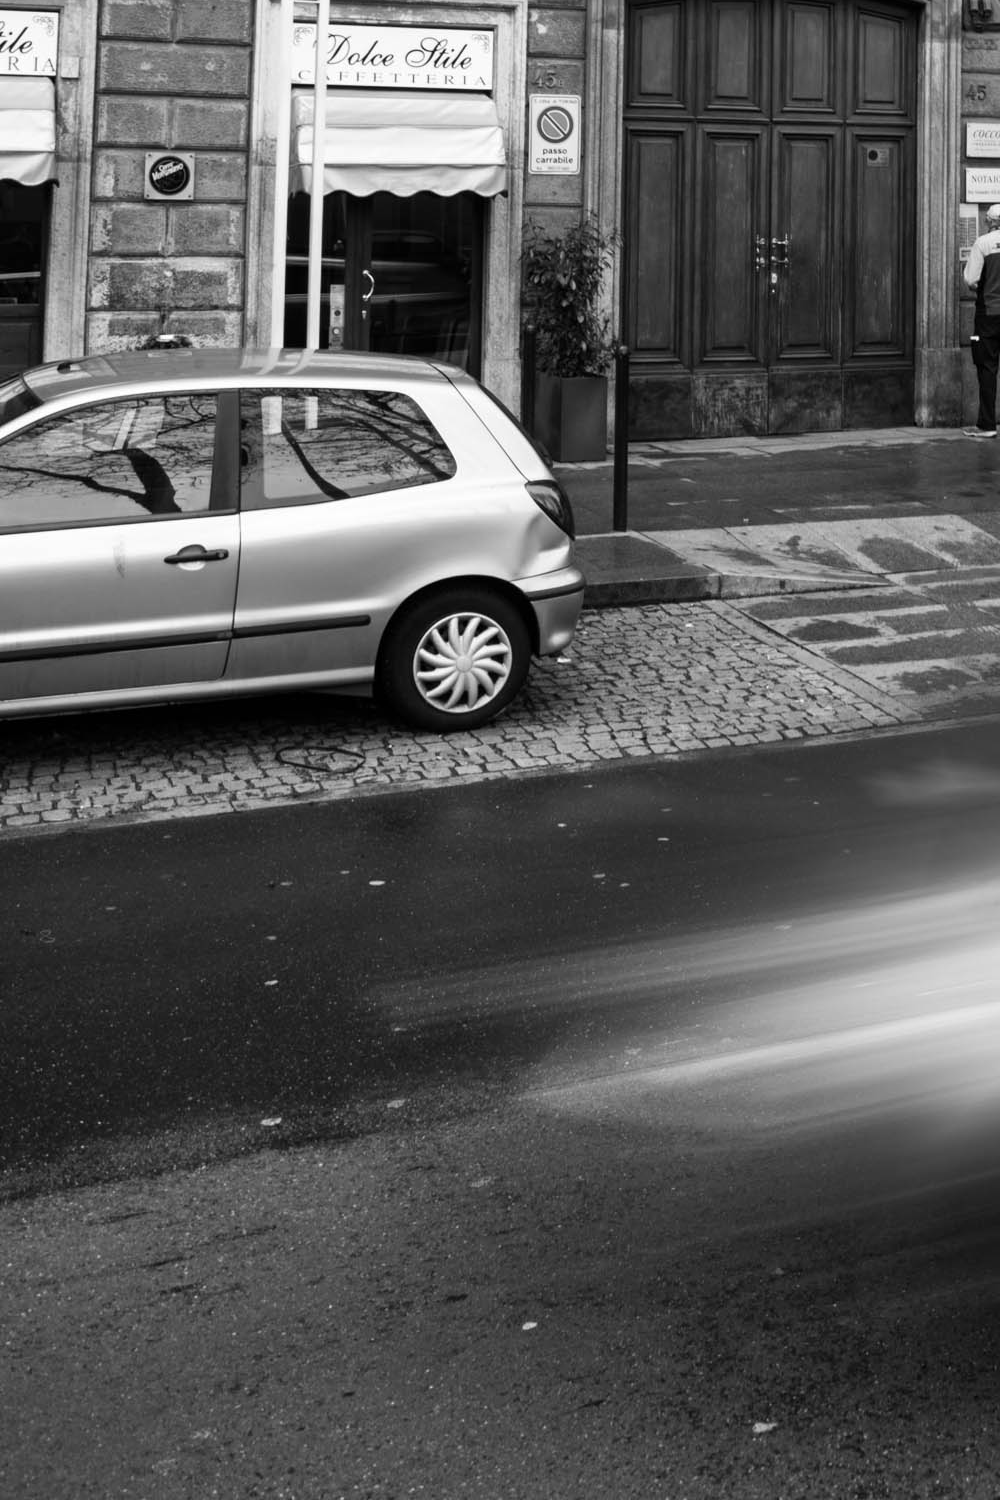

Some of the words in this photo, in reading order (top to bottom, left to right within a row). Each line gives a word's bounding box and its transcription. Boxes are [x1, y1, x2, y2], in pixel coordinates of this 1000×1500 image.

[313, 33, 395, 67] Dolce
[404, 37, 473, 70] Stile
[298, 69, 487, 86] CFFETTERIA
[965, 84, 987, 101] 45
[535, 155, 574, 164] carrabile
[542, 147, 568, 156] passo
